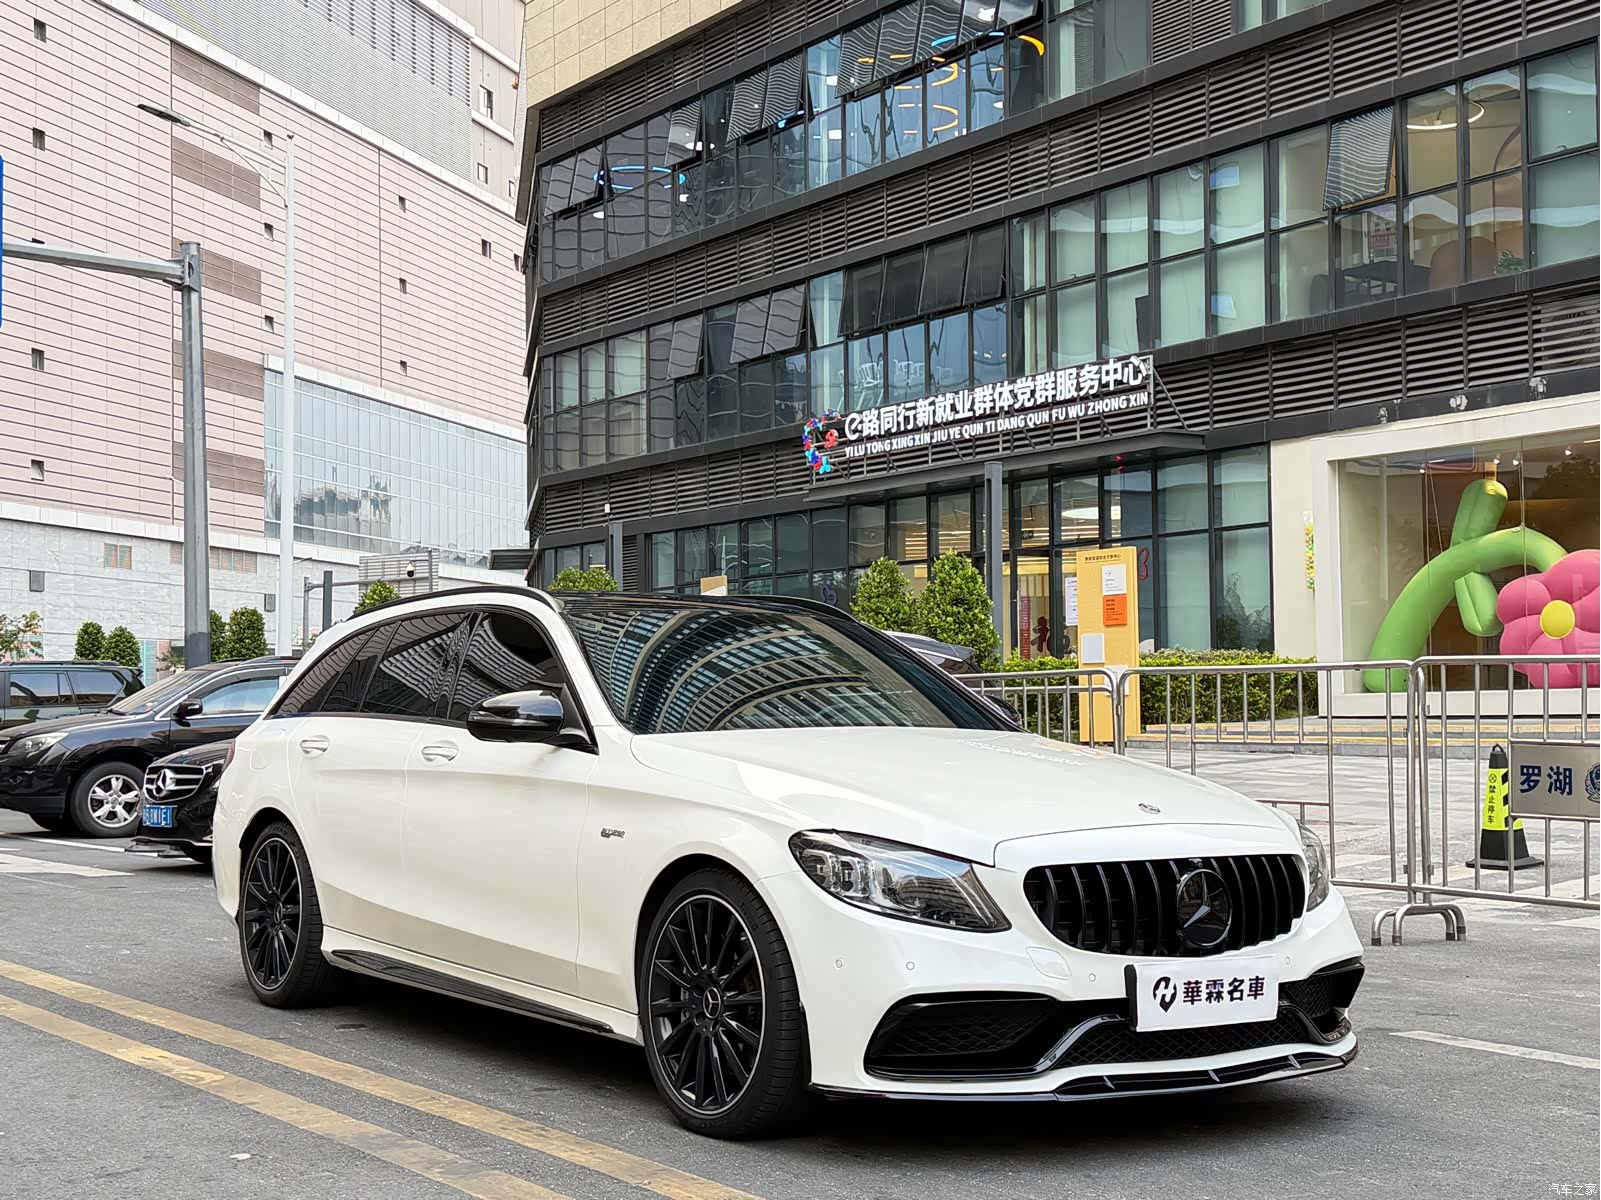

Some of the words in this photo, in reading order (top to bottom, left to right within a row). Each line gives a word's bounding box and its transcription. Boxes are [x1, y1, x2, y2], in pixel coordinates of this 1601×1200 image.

[866, 439, 891, 454] TONG
[892, 435, 914, 450] XING
[914, 432, 931, 446] XIN
[931, 429, 948, 443] JIU
[948, 426, 961, 440] YE
[962, 422, 984, 439] QUN
[985, 420, 996, 434] TI
[997, 415, 1025, 432] DANG
[1026, 410, 1050, 428] QUN
[1052, 407, 1066, 421] FU
[1067, 403, 1085, 419] WU
[1087, 395, 1127, 415] ZHONG
[1128, 391, 1148, 408] XIN
[1519, 764, 1573, 796] 罗湖
[1487, 785, 1497, 825] 禁止停车
[1182, 975, 1265, 1005] 華霖名車
